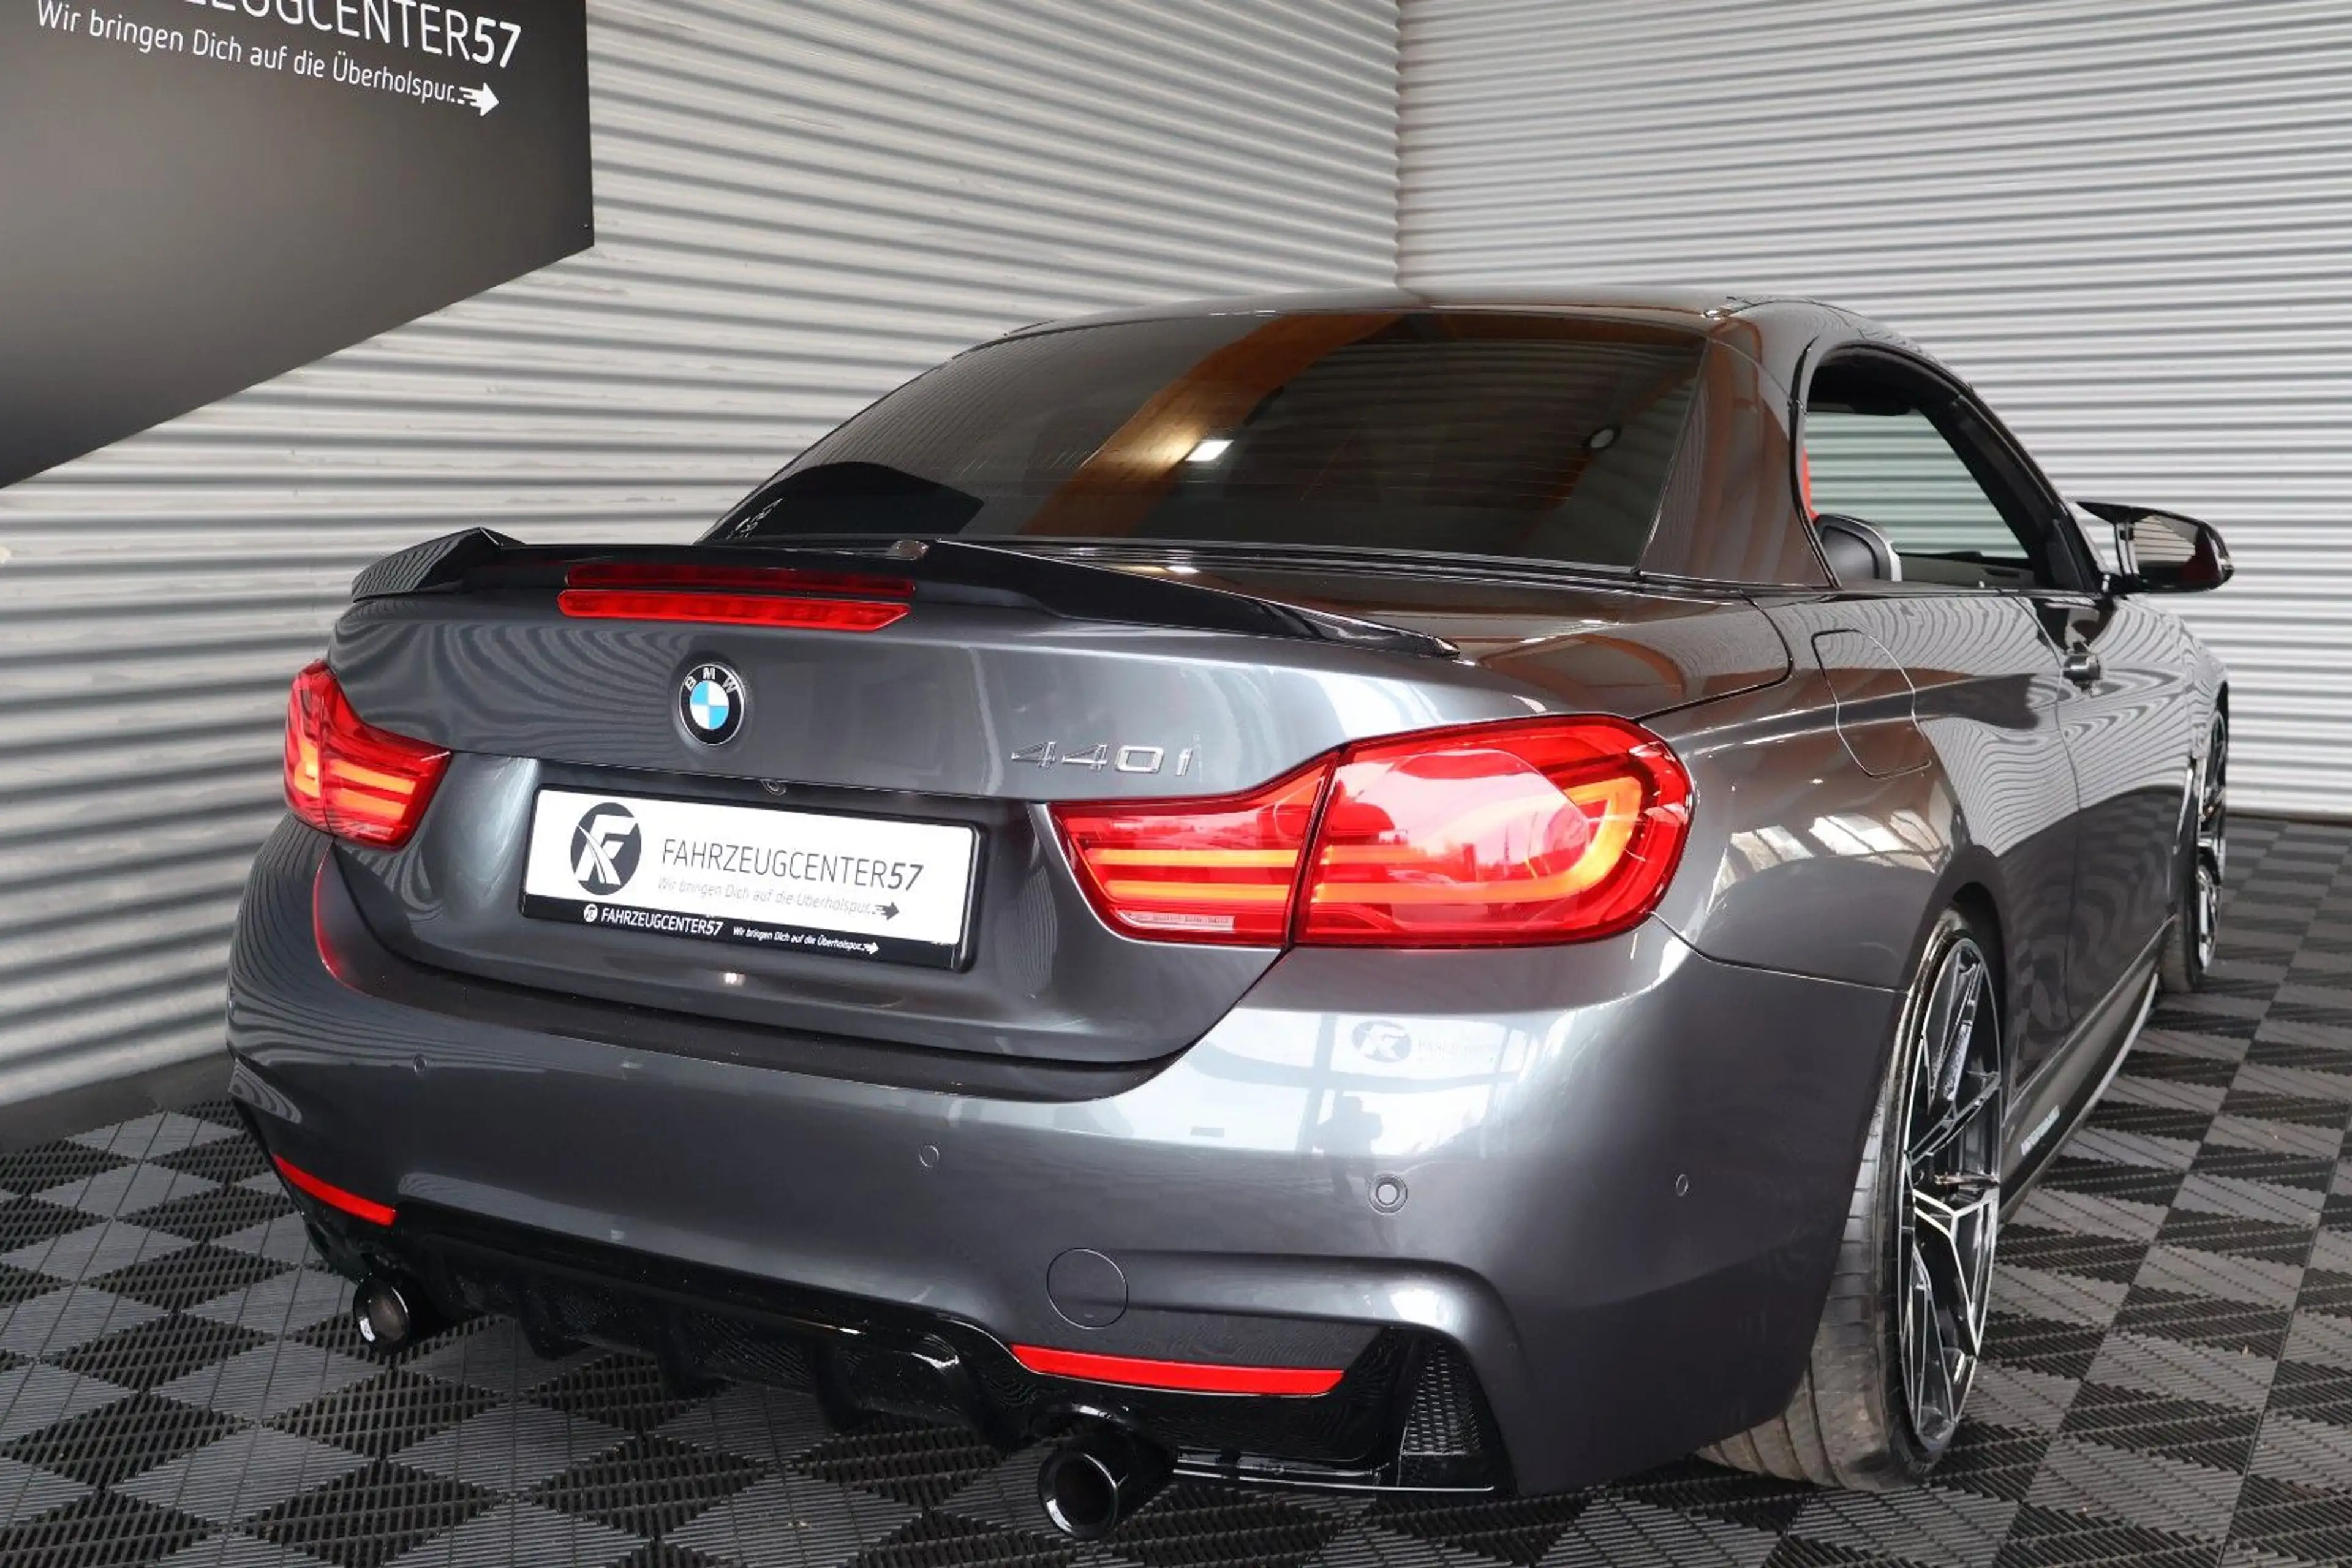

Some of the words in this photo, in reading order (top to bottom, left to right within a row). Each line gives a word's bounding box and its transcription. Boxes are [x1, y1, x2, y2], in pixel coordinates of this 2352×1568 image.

[37, 0, 81, 32] Wir
[89, 9, 184, 53] bringen
[192, 29, 242, 62] Dich
[249, 45, 288, 70] auf
[293, 50, 325, 78] die
[184, 0, 521, 68] CENTER57
[684, 666, 738, 694] BMW
[662, 838, 924, 891] FAHRZEUGCENTER57
[725, 884, 750, 900] Dich
[752, 888, 774, 902] auf
[775, 890, 794, 905] die
[601, 907, 724, 936] FAHRZEUGCENTER57
[733, 926, 745, 937] Wir
[745, 927, 773, 941] bringen
[774, 931, 790, 942] Dich
[791, 934, 805, 943] auf
